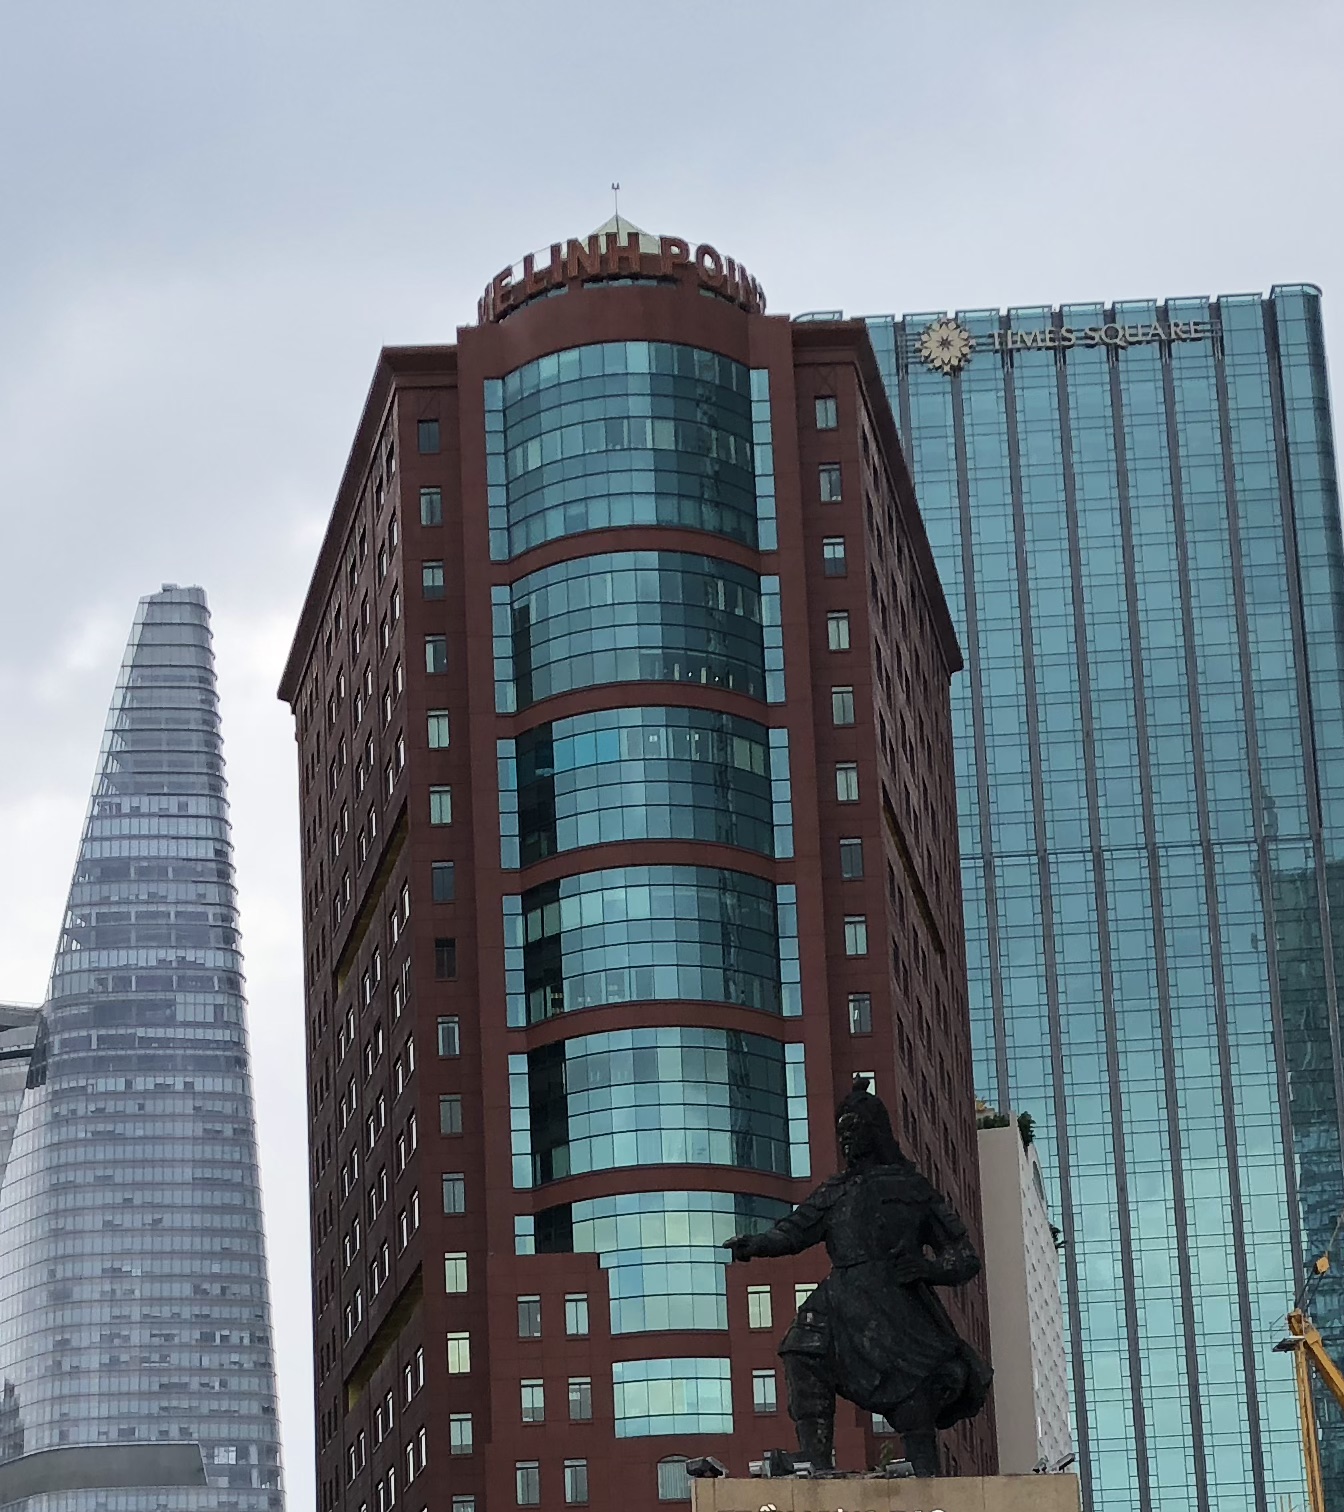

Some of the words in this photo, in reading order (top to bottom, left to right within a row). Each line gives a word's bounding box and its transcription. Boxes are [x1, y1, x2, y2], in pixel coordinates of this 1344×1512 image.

[523, 231, 641, 294] LINH
[993, 326, 1076, 349] TIMES
[1084, 320, 1204, 346] SQUARE
